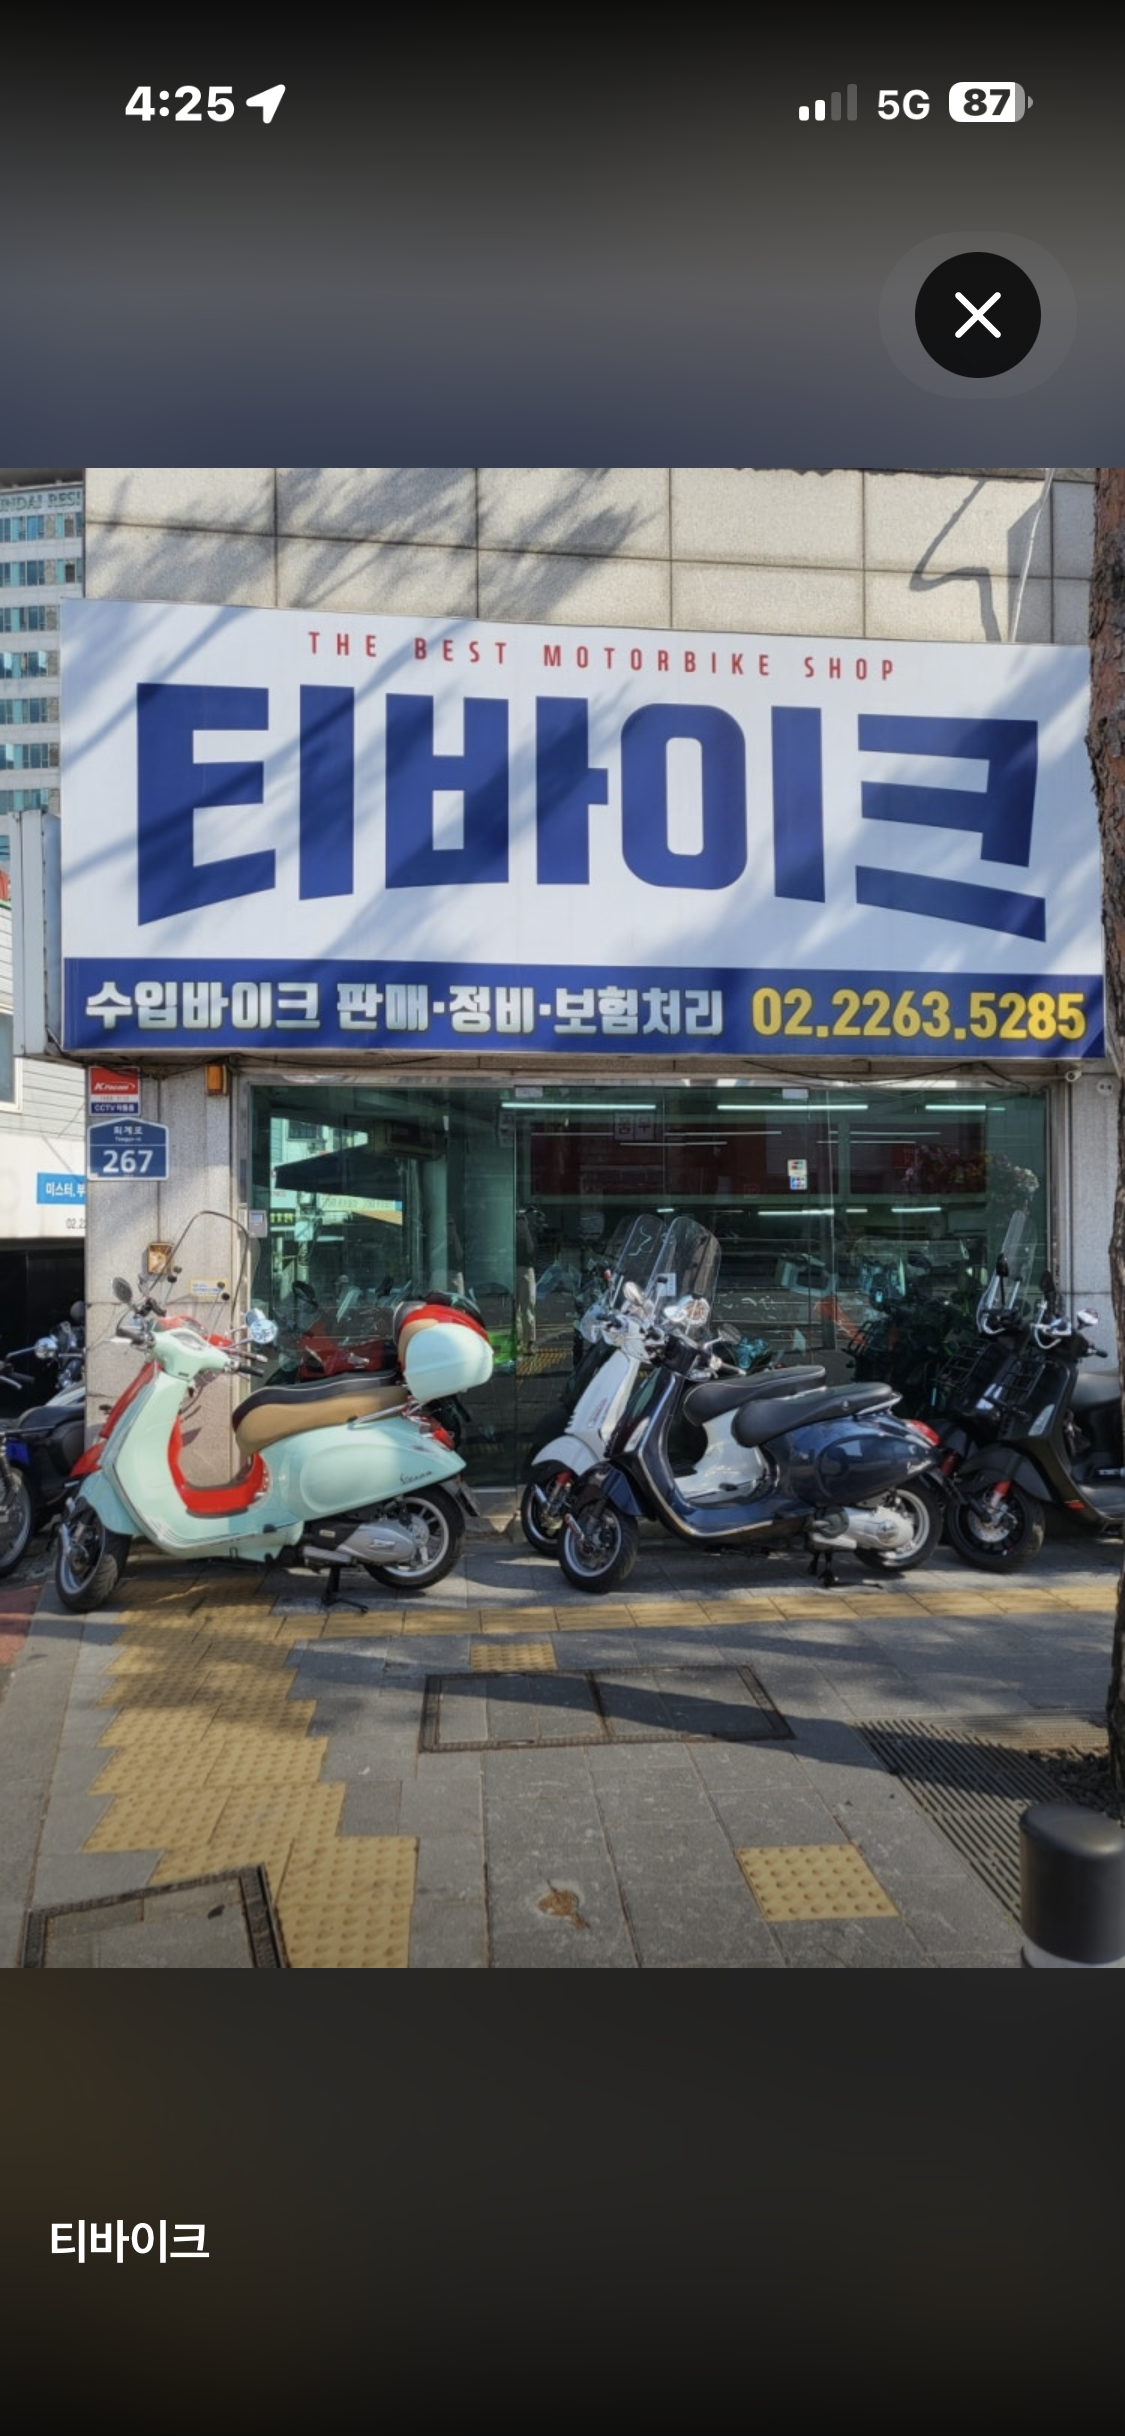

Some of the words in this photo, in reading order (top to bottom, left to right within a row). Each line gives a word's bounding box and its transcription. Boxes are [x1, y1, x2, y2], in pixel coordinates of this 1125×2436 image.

[309, 631, 378, 659] THE
[415, 638, 508, 666] BEST
[542, 643, 772, 678] MOTORBIKE
[803, 655, 896, 682] SHOP
[136, 682, 1046, 942] 티바이크
[85, 981, 321, 1031] 수입바이크
[752, 988, 1086, 1040] 02.2263.5285
[94, 1103, 117, 1113] CCTV
[102, 1149, 154, 1174] 267
